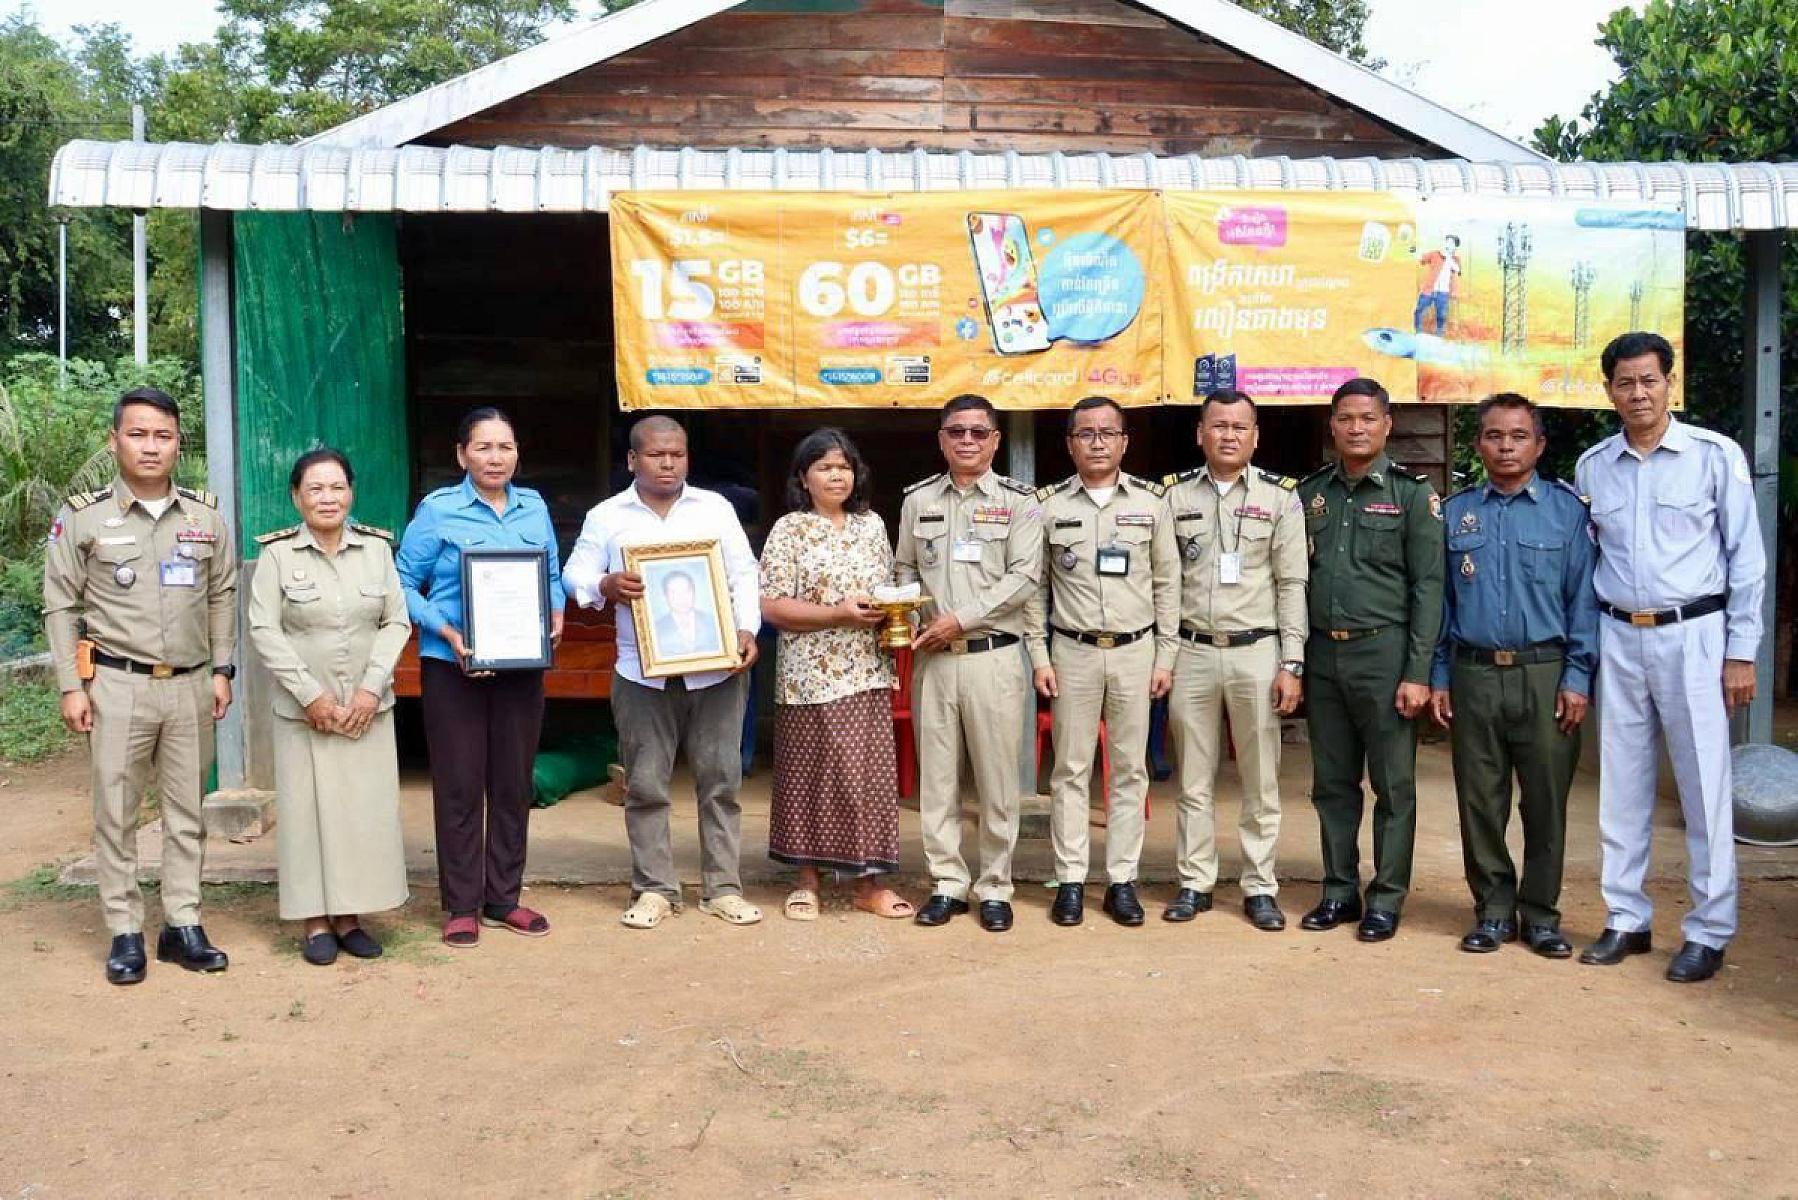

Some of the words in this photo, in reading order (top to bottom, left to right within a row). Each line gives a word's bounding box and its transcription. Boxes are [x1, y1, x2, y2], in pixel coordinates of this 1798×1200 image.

[630, 259, 715, 320] 15
[717, 259, 765, 284] GB
[799, 261, 895, 317] 60
[898, 263, 942, 285] GB
[1088, 367, 1118, 386] 4G
